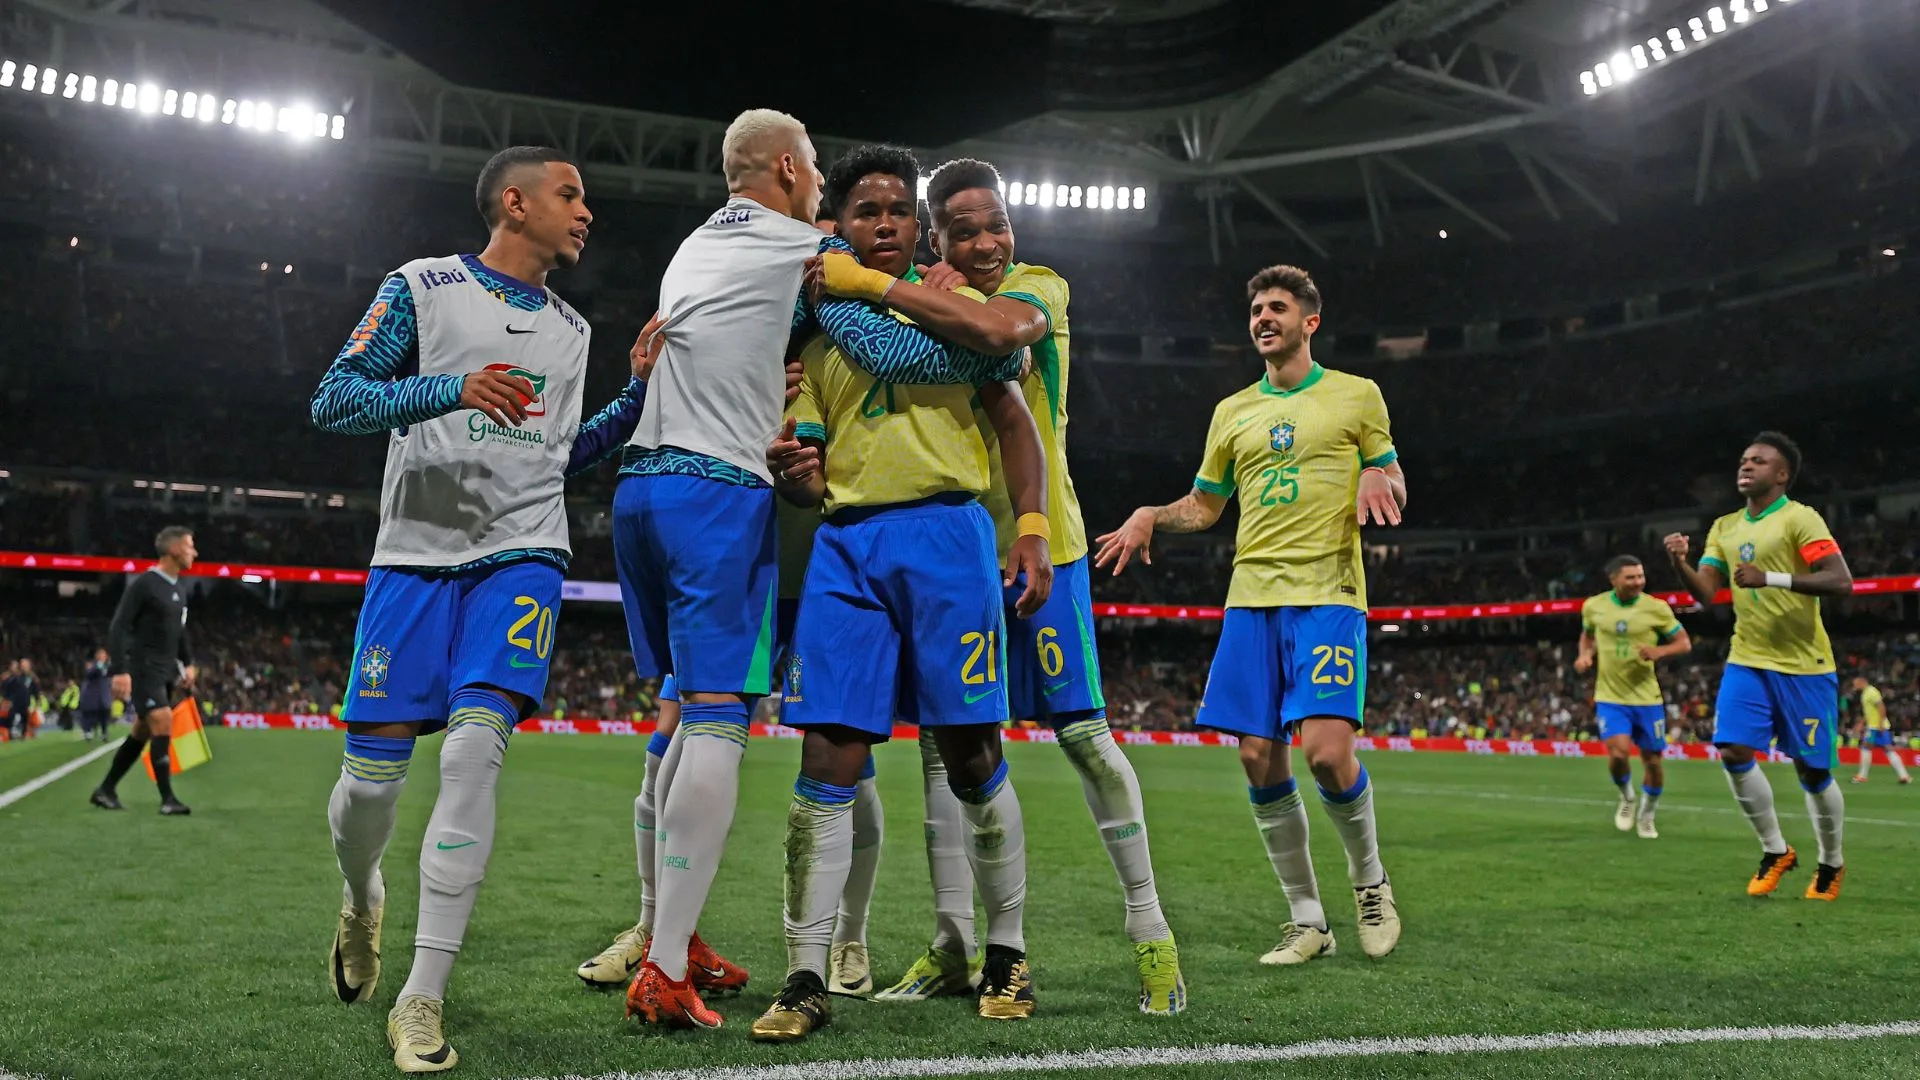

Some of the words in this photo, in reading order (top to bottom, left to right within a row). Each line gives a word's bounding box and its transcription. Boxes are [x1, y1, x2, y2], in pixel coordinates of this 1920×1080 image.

[418, 268, 467, 290] Itaú
[347, 301, 389, 355] vivo
[552, 298, 585, 336] Itaú
[467, 412, 546, 444] Guaraná
[491, 436, 535, 450] ANTARCTICA
[1260, 467, 1299, 506] 25
[507, 595, 553, 660] 20
[960, 630, 997, 685] 21
[1036, 626, 1064, 677] 6
[1311, 645, 1354, 686] 25
[359, 689, 388, 698] BRASIL
[223, 712, 271, 730] TCL
[290, 713, 336, 731] TCL
[538, 719, 580, 735] TCL
[598, 720, 638, 736] TCL
[1803, 718, 1820, 747] 7
[1123, 731, 1157, 745] TCL
[1170, 732, 1204, 747] TCL
[1217, 733, 1240, 748] TC
[1464, 739, 1494, 755] TCL
[1506, 740, 1539, 756] TCL
[1551, 741, 1586, 757] TCL
[1661, 744, 1689, 760] CL
[664, 855, 690, 870] RASIL
